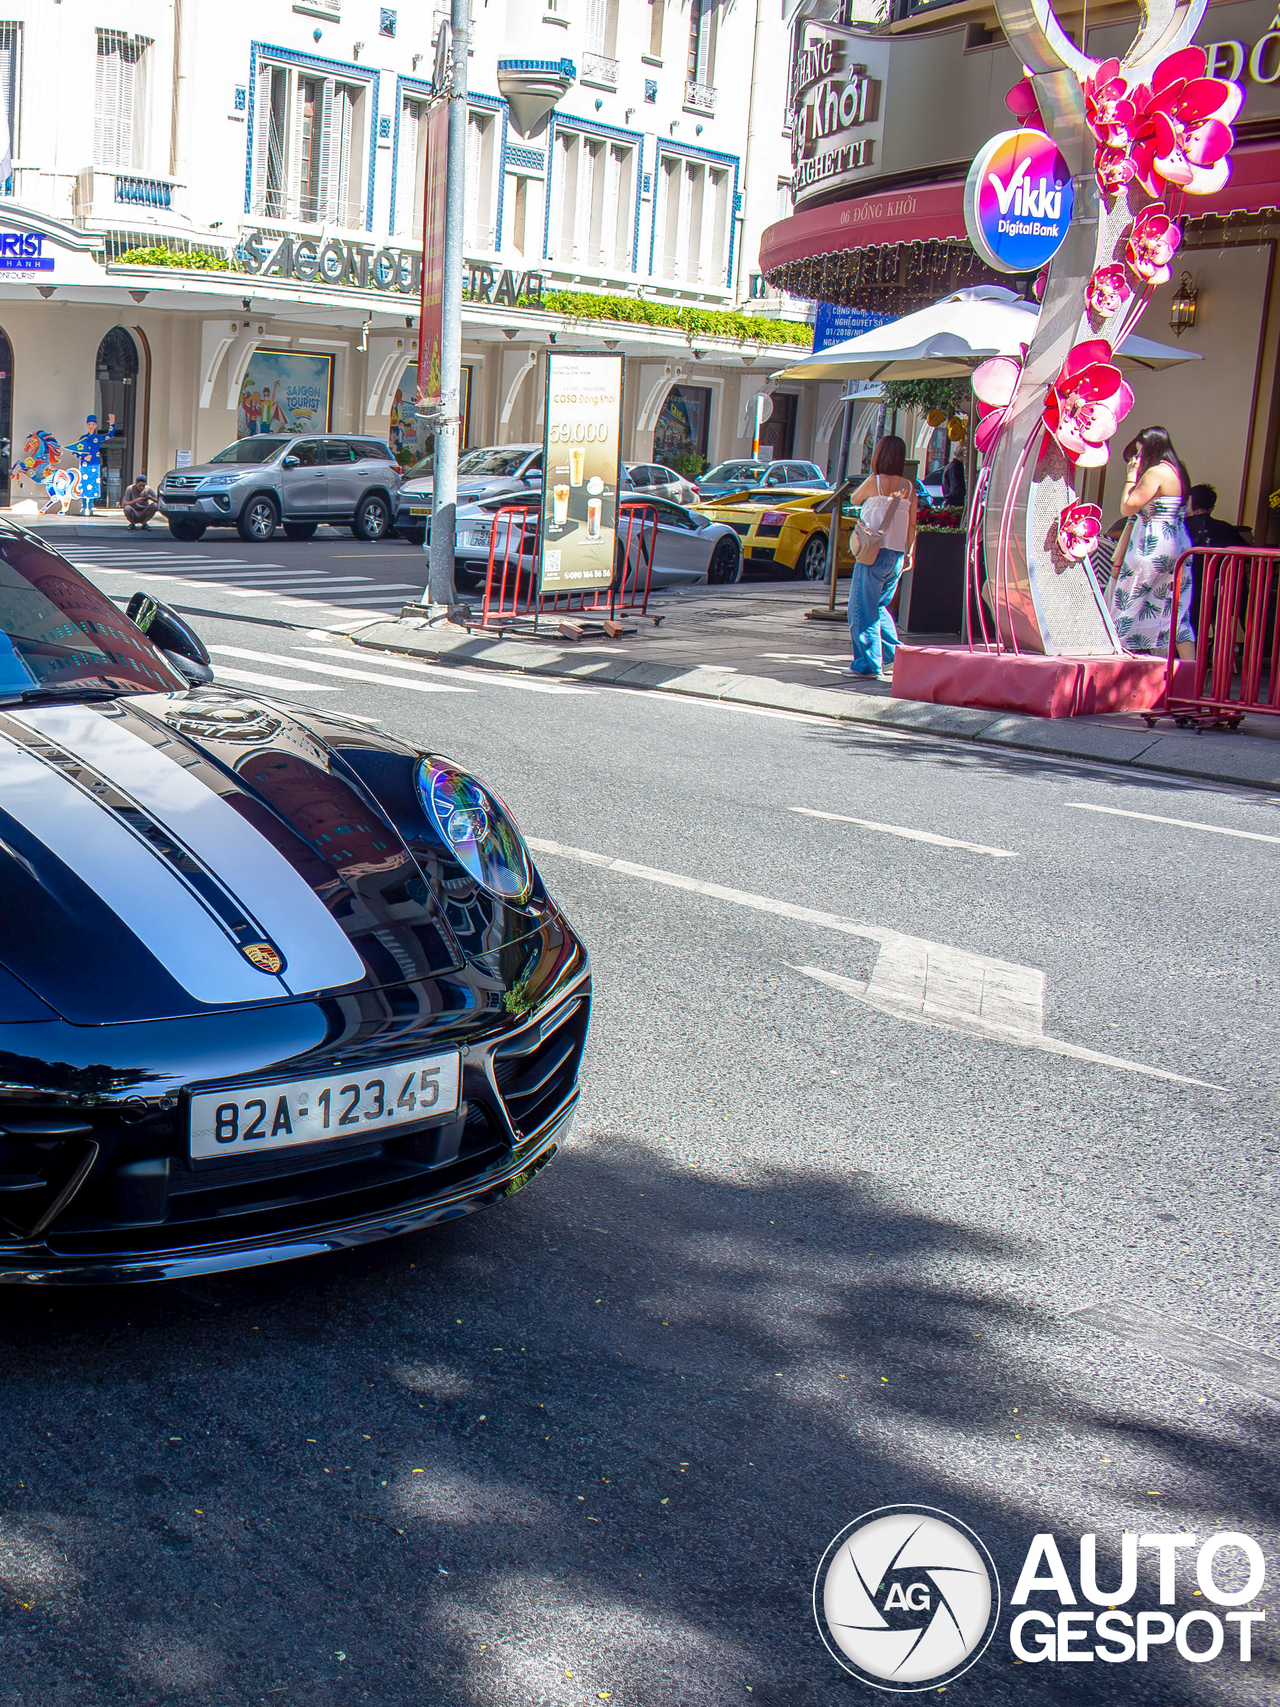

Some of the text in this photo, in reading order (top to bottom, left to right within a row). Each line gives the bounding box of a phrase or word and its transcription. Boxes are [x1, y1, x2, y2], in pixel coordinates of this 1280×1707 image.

[812, 64, 869, 139] Khởi
[988, 157, 1062, 219] Vikki
[840, 210, 850, 225] 06
[998, 219, 1059, 238] Digital Bank
[286, 396, 320, 409] TOURIST
[550, 423, 608, 444] 59.000
[215, 1067, 440, 1143] 82A-123.45
